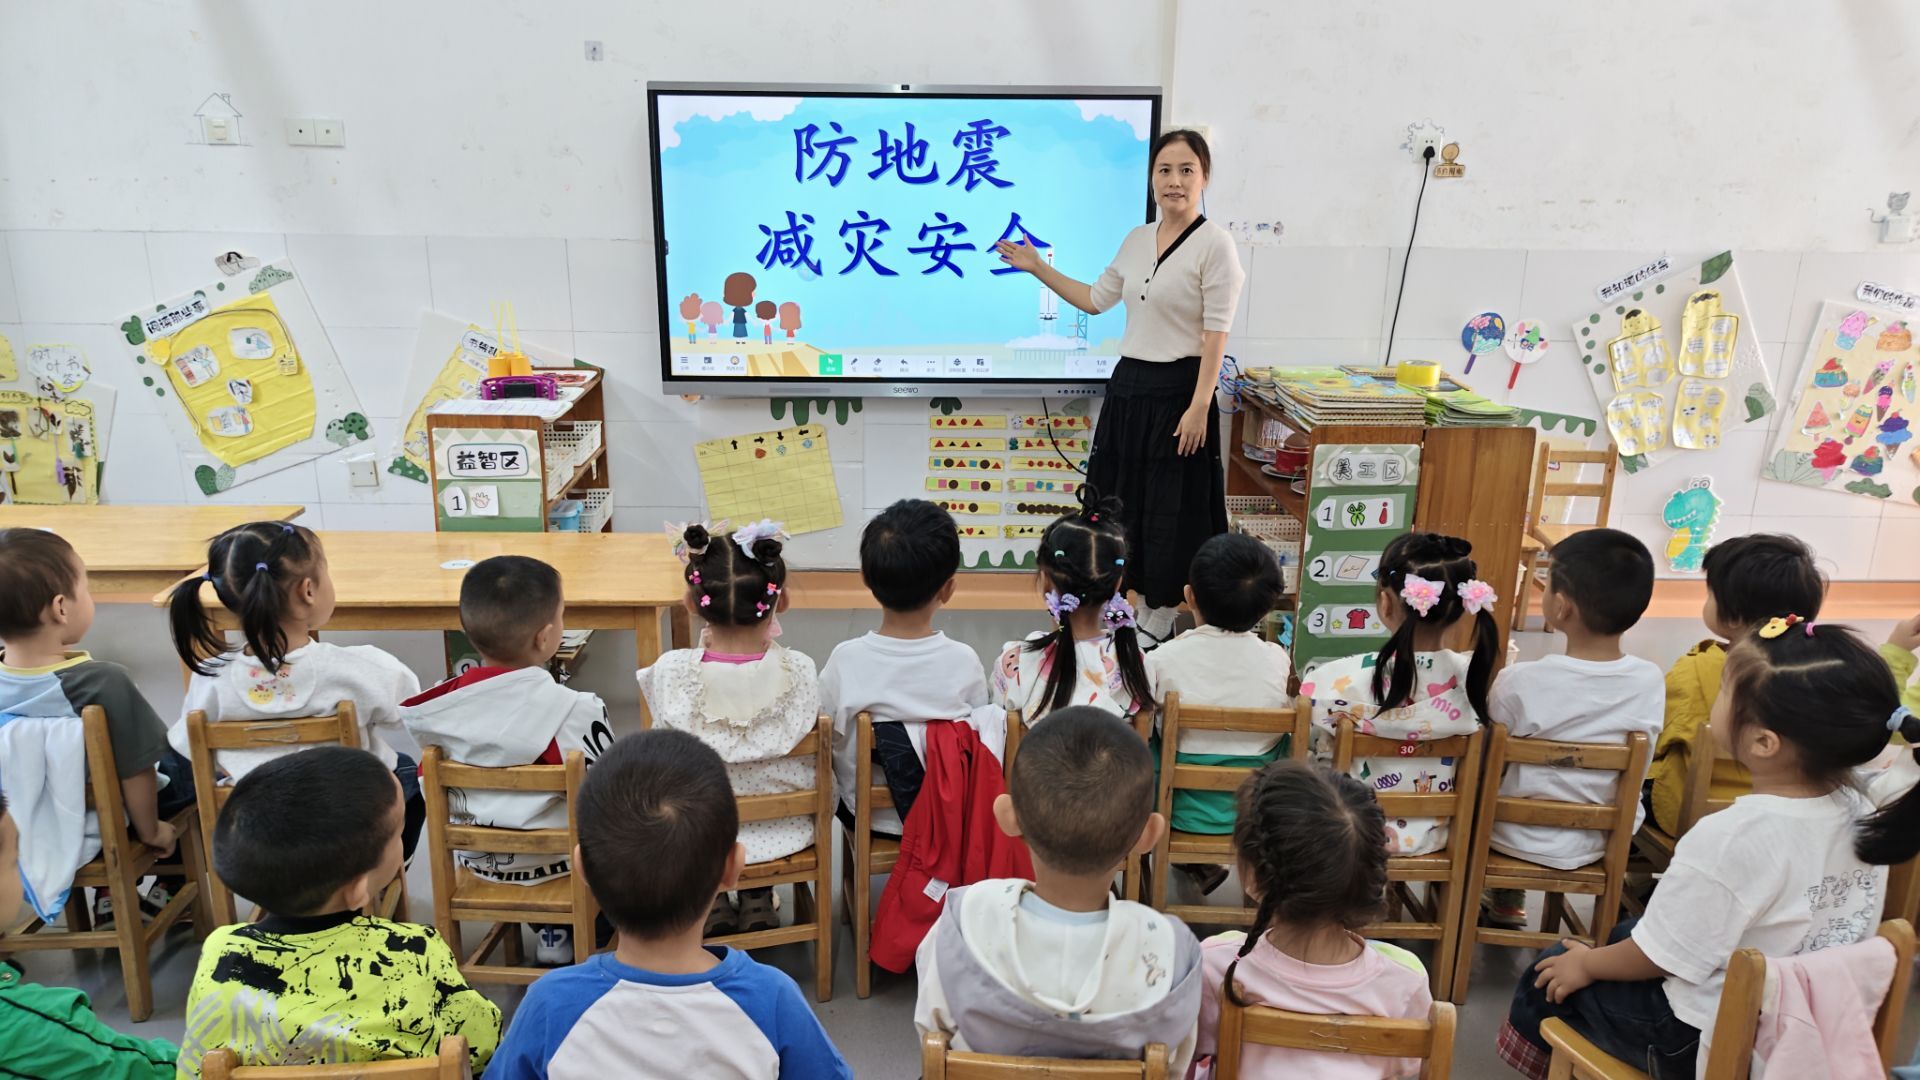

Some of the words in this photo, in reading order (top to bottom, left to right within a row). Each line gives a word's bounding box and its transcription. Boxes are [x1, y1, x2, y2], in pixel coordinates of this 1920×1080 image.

[793, 118, 1015, 192] 防地震
[755, 210, 1052, 279] 减灾安全
[146, 300, 205, 334] 阅读那些事
[893, 386, 919, 394] seewo
[456, 450, 520, 470] 益智区
[1333, 458, 1400, 481] 美工区
[452, 495, 463, 511] 1
[1322, 506, 1332, 522] 1
[1313, 612, 1325, 627] 3
[1400, 745, 1415, 754] 30
